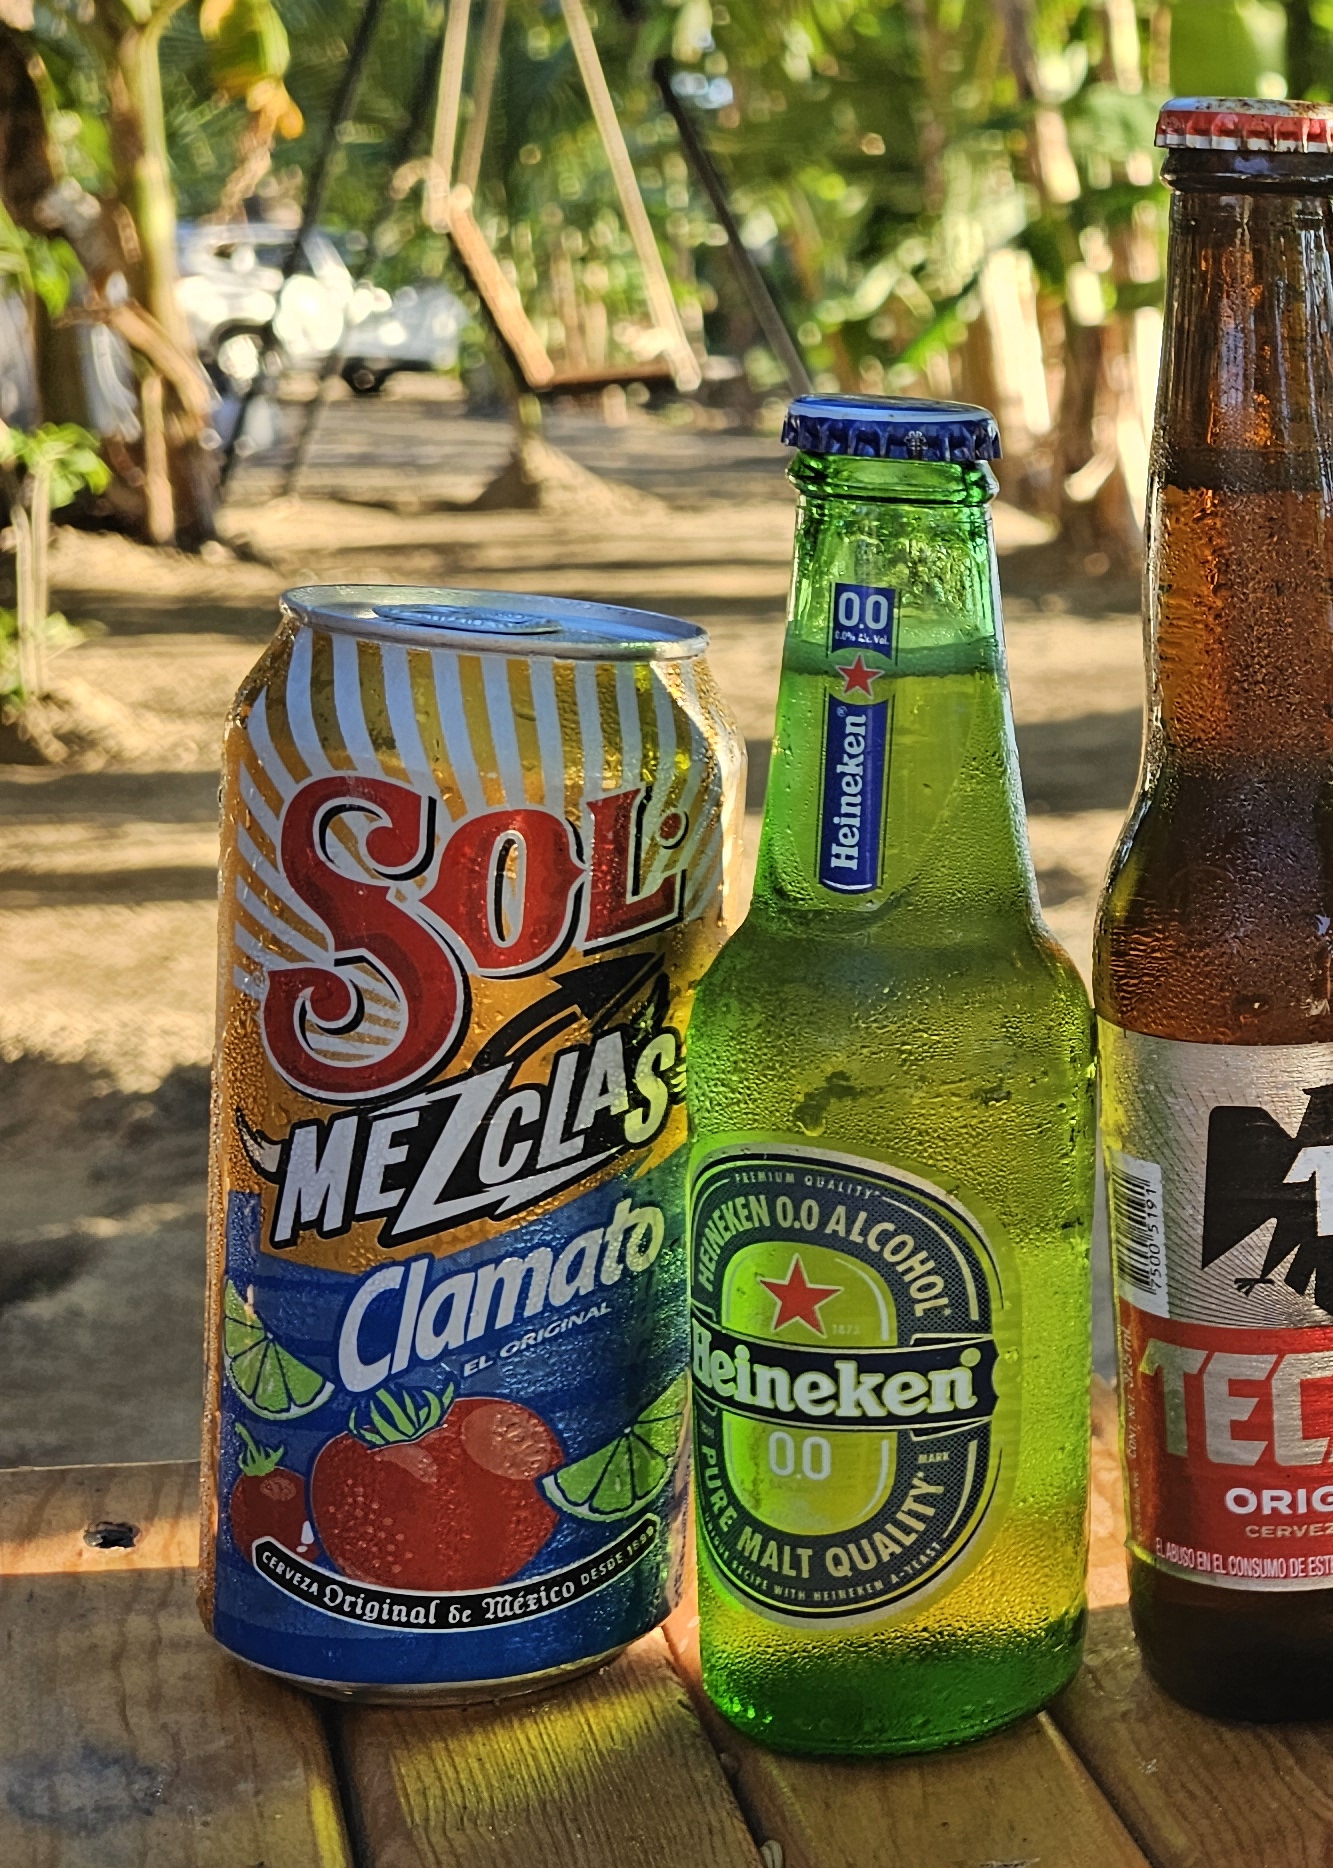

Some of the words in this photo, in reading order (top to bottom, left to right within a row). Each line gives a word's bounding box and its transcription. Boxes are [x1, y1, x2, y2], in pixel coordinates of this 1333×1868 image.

[838, 591, 889, 630] 0.0
[830, 713, 867, 871] Heineken
[264, 777, 685, 1099] SOL
[275, 1030, 676, 1242] MEZCLAS
[735, 1171, 795, 1184] PREMIUM
[804, 1175, 875, 1199] QUALITY
[338, 1199, 664, 1392] Clamato
[698, 1195, 771, 1292] HEINEKEN
[777, 1196, 819, 1231] 0.0
[825, 1204, 950, 1317] ALCOHOL
[463, 1356, 494, 1377] EL
[499, 1301, 612, 1358] ORIGINAL
[693, 1326, 981, 1418] Heineken
[768, 1431, 833, 1482] 0.0
[701, 1444, 738, 1532] PURE
[736, 1525, 813, 1579] MALT
[825, 1480, 945, 1577] QUALITY
[261, 1550, 319, 1597] CERVEZA
[322, 1584, 438, 1625] Original
[447, 1604, 473, 1624] de
[481, 1580, 576, 1620] México
[580, 1555, 624, 1587] DESDE
[731, 1560, 769, 1591] RECIPE
[773, 1584, 806, 1601] WITH
[889, 1541, 942, 1584] A-YEAST
[1154, 1537, 1166, 1558] EL
[1166, 1546, 1195, 1570] ABUSO
[1196, 1551, 1211, 1572] EN
[1213, 1554, 1227, 1575] EL
[1229, 1557, 1286, 1578] CONSUMO
[1289, 1558, 1307, 1578] DE
